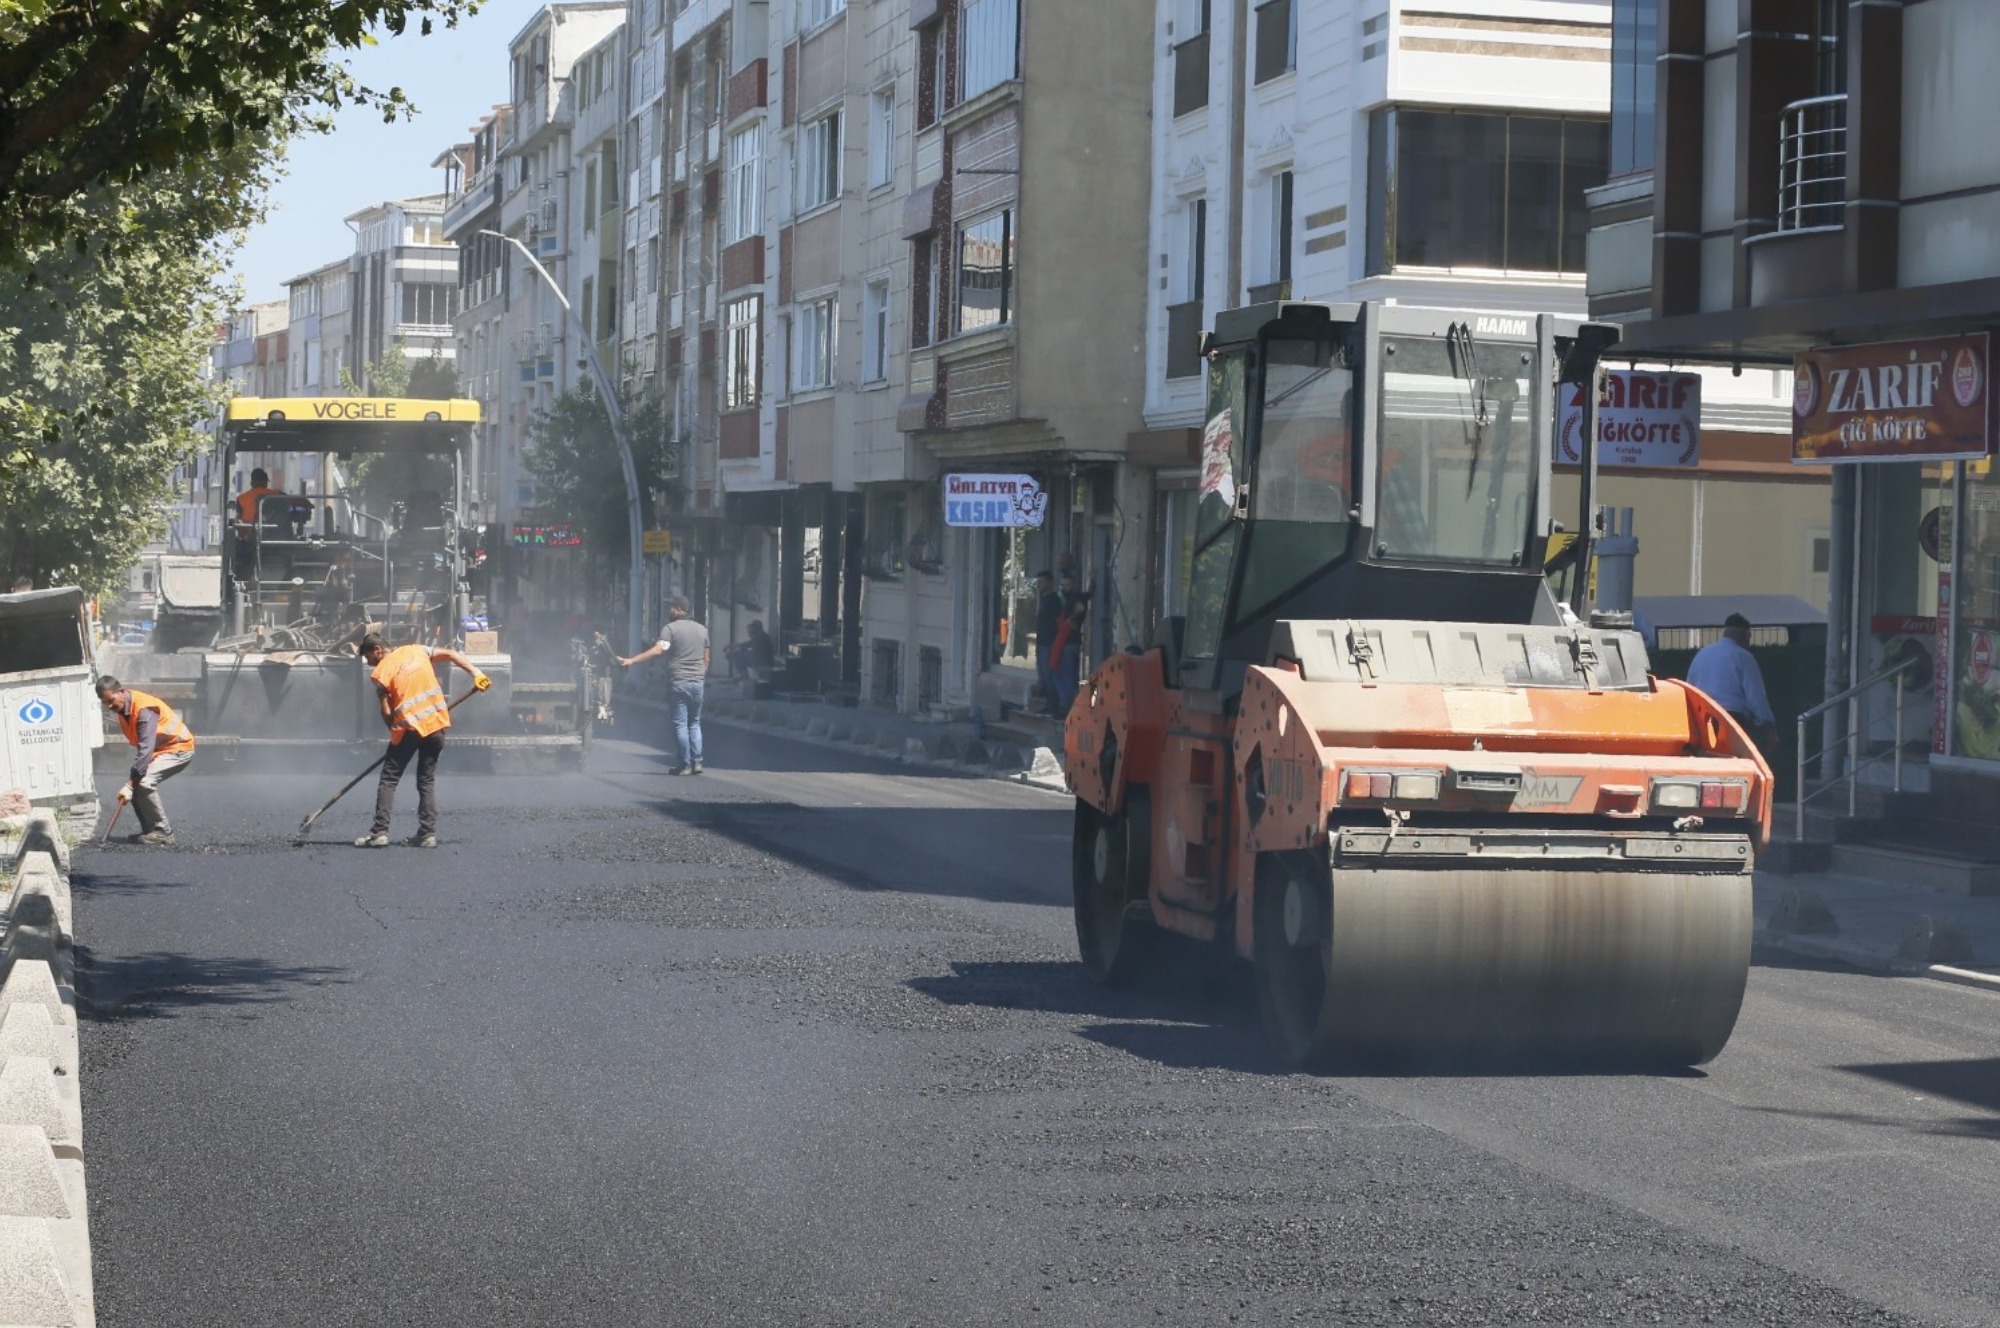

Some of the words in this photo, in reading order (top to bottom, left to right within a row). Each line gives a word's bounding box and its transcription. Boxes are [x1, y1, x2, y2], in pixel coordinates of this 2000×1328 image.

[1477, 316, 1527, 336] HAMM
[1827, 348, 1943, 413] ZARİF
[313, 400, 397, 419] VÖGELE
[1840, 417, 1867, 449] ÇİĞ
[1872, 415, 1926, 441] KÖFTE
[950, 481, 1017, 494] MALATYA
[948, 501, 1009, 522] KASAP
